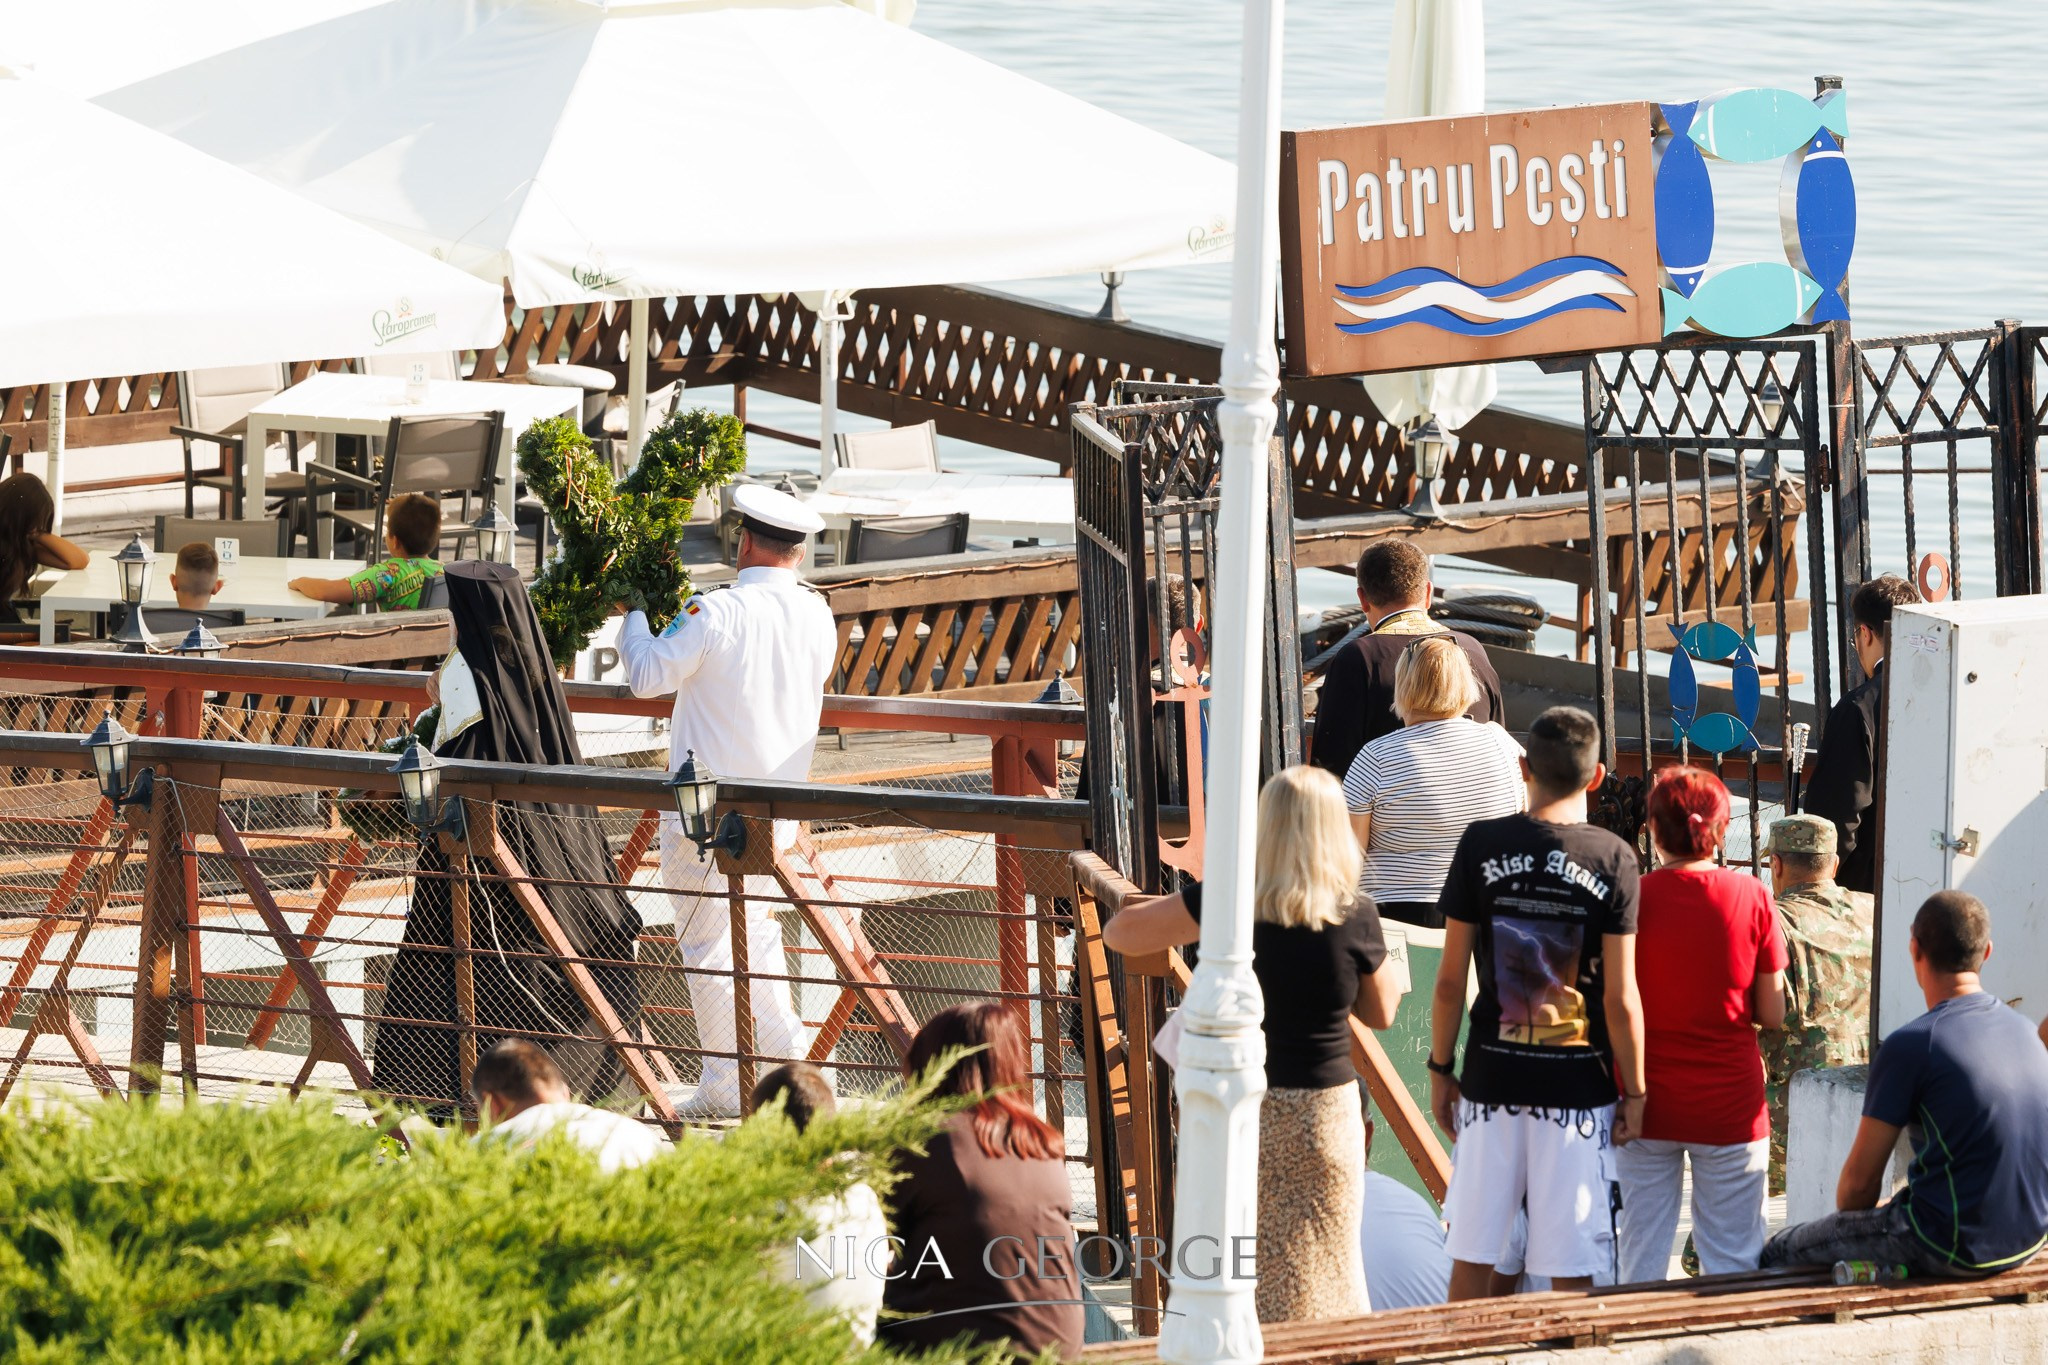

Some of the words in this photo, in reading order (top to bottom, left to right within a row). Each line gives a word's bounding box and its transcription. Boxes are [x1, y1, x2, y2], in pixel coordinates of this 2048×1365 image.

[1319, 157, 1476, 246] Patru
[1489, 138, 1629, 239] Pești
[372, 309, 438, 347] Staropramen
[221, 540, 233, 550] 17
[1480, 852, 1535, 887] Rise
[1544, 849, 1610, 901] Again
